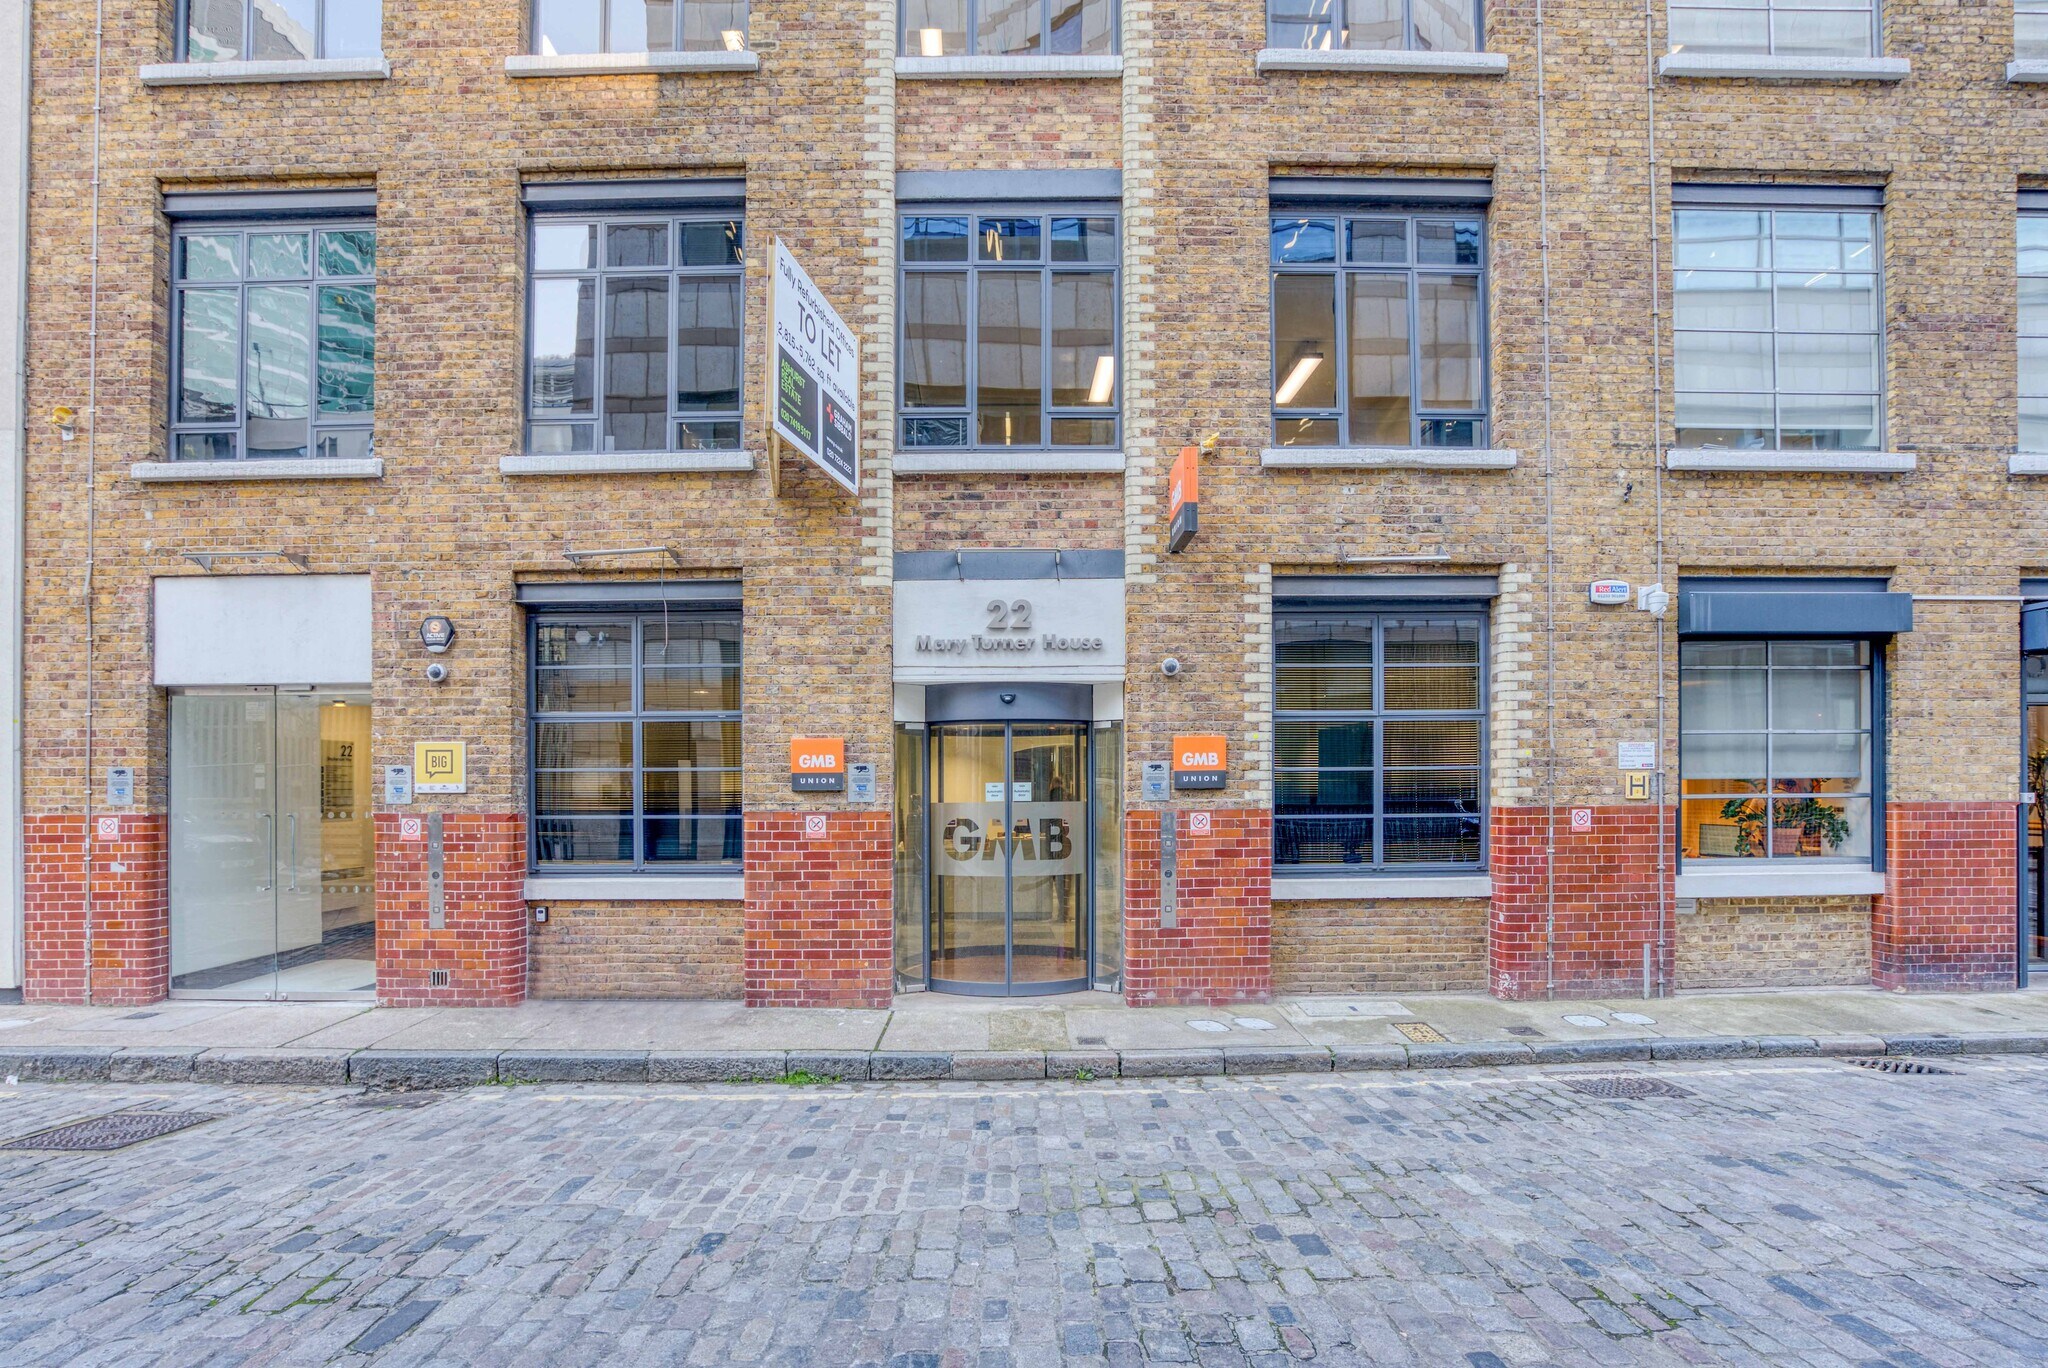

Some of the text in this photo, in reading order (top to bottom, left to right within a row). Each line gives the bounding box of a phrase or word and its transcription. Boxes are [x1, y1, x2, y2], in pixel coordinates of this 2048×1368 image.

[780, 257, 855, 359] Fully Refurbished Offices
[798, 300, 842, 373] TO LET
[781, 380, 802, 405] ESTATE
[986, 599, 1033, 629] 22
[914, 633, 1103, 654] Mary Turner House
[340, 744, 353, 757] 22
[798, 754, 836, 768] GMB
[1181, 752, 1219, 766] GMB
[431, 755, 448, 768] BIG
[1630, 775, 1646, 796] H
[943, 818, 1072, 861] GMB
